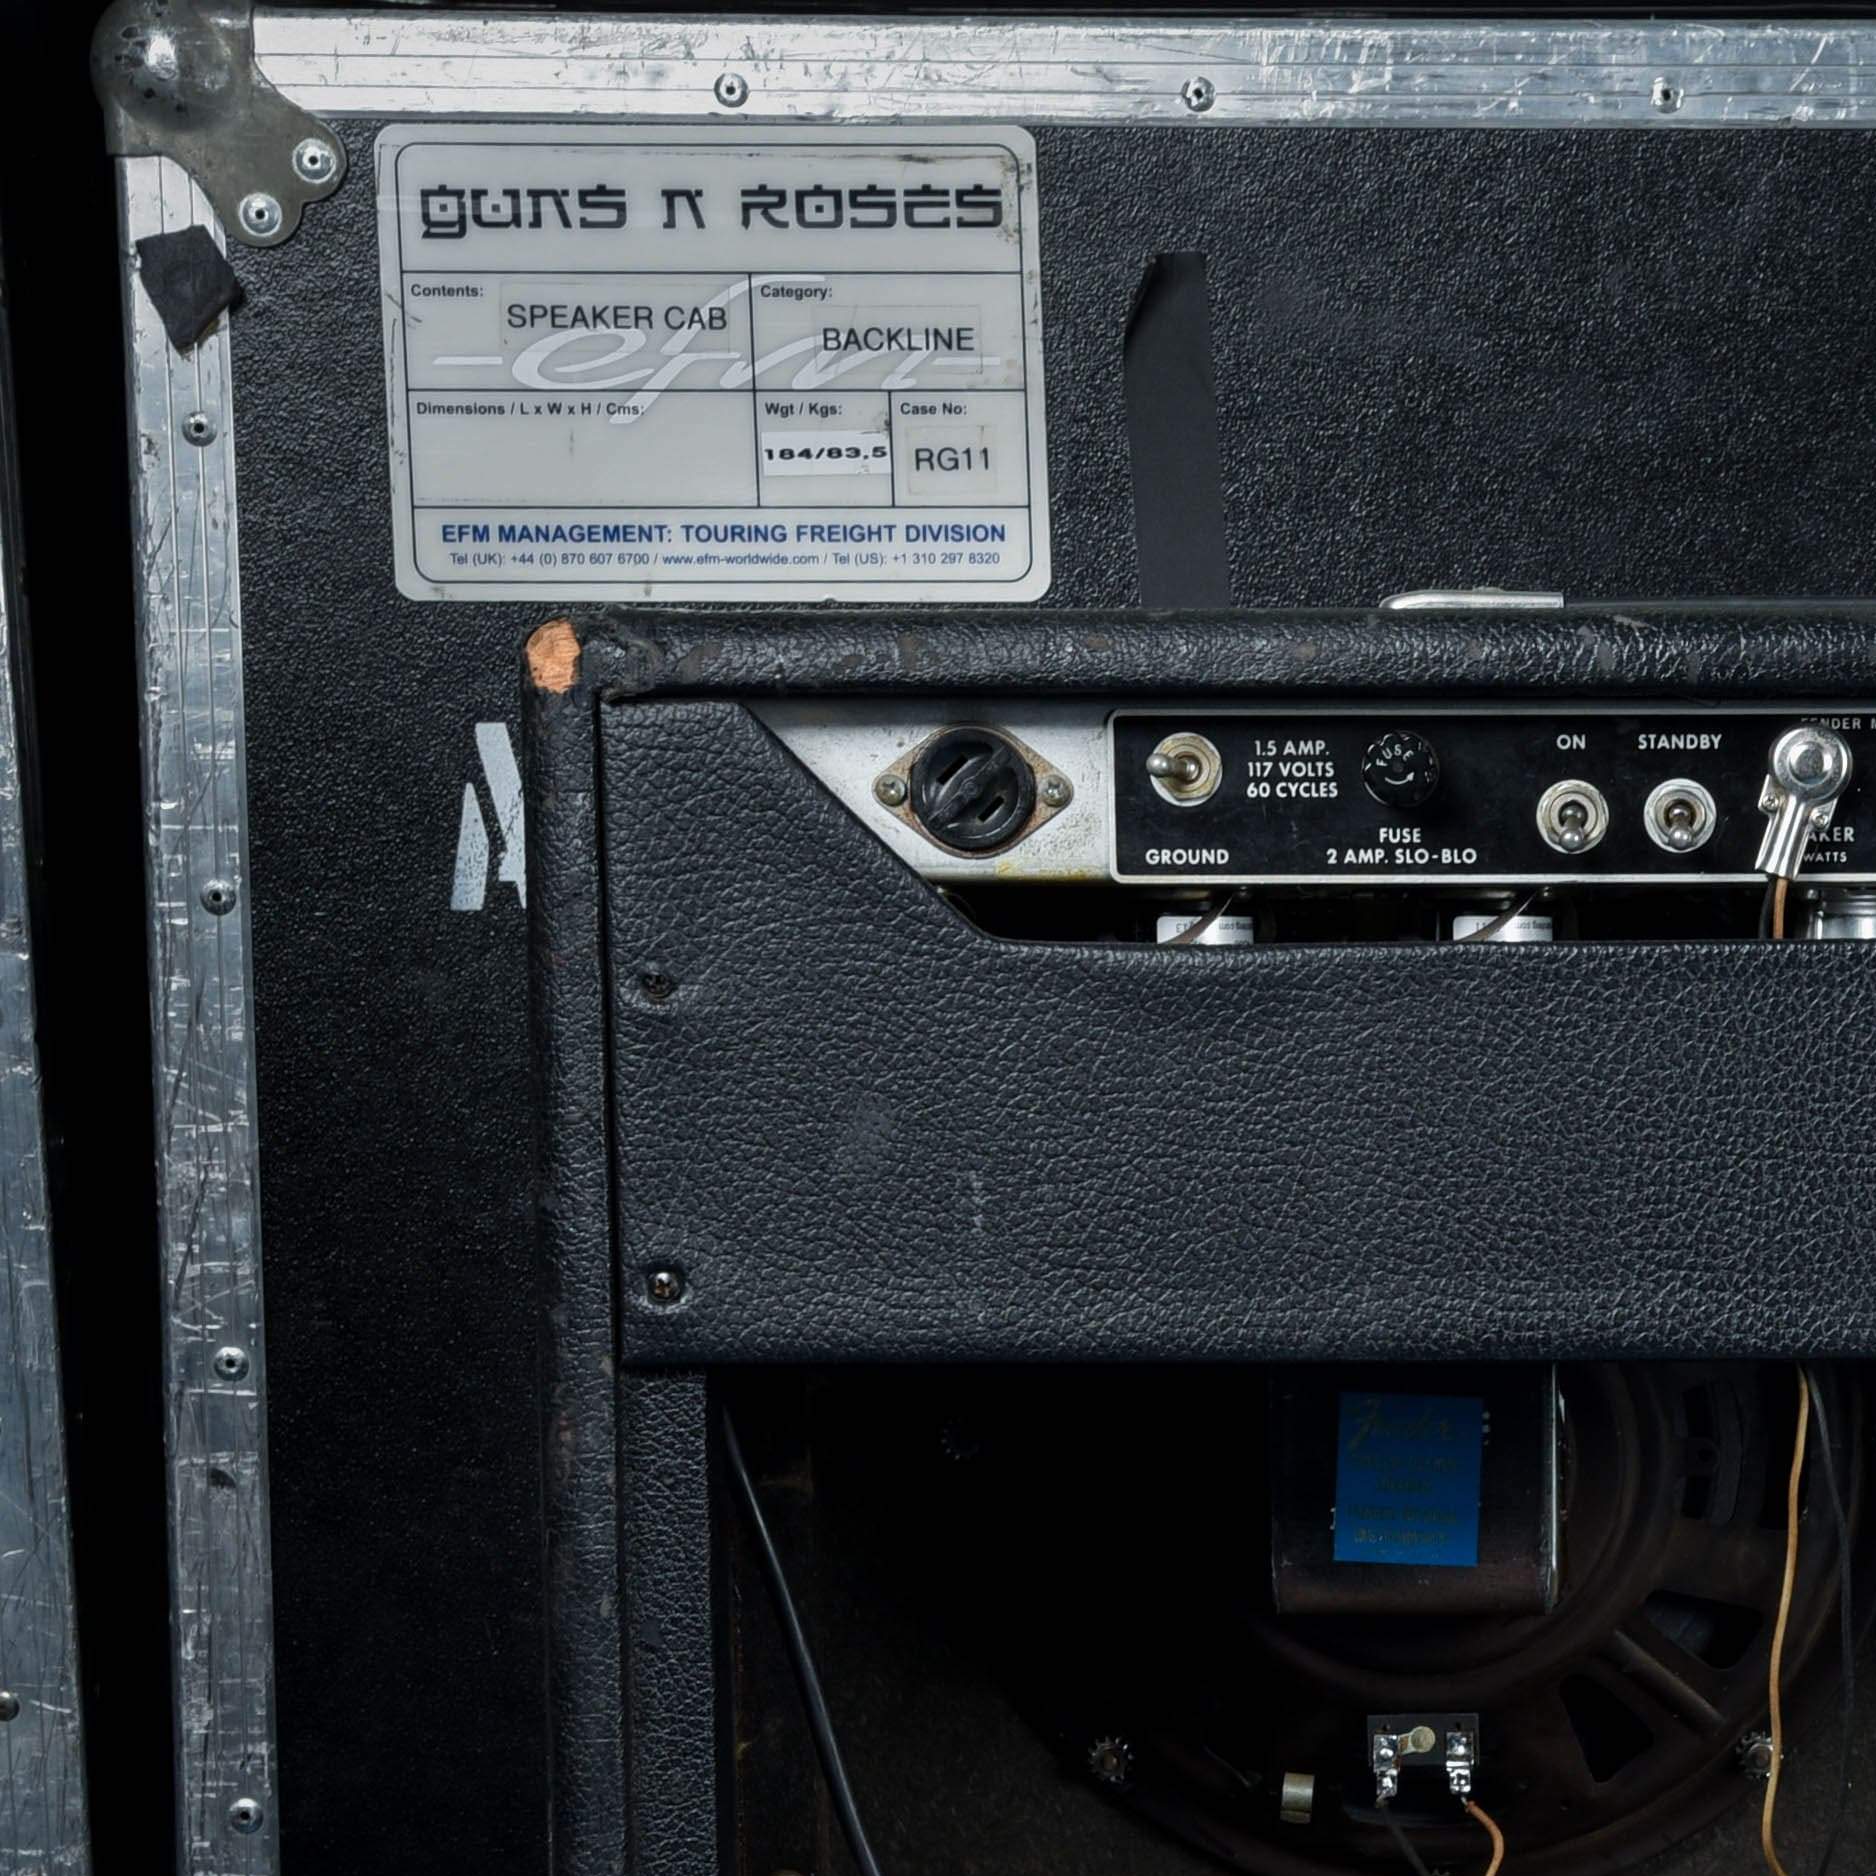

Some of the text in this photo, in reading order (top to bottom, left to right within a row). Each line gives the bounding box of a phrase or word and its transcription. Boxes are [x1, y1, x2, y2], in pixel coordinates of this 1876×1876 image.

[741, 184, 1002, 229] ROSES
[411, 284, 484, 297] Contents:
[760, 285, 832, 300] Category:
[507, 305, 727, 330] SPEAKER CAB
[823, 327, 974, 350] BACKLINE
[416, 402, 505, 416] Dimensions
[521, 403, 528, 415] L
[534, 406, 542, 415] x
[547, 402, 562, 415] W
[567, 406, 575, 416] x
[581, 403, 591, 415] H
[606, 402, 645, 416] Cms:
[765, 403, 795, 417] Wgt
[809, 403, 843, 417] Kgs:
[900, 403, 967, 415] Case No:
[915, 448, 990, 471] RG11
[442, 524, 1006, 543] EFM MANAGEMENT: TOURING FREIGHT DIVISION
[450, 553, 468, 565] Tel
[473, 552, 505, 567] (UK):
[511, 554, 534, 565] +44
[539, 553, 557, 567] (0)
[561, 553, 584, 565] 870
[590, 553, 612, 565] 607
[618, 553, 649, 565] 6700
[662, 553, 819, 565] www.efm-worldwide.com
[833, 553, 850, 564] Tel
[854, 553, 888, 566] (US):
[893, 553, 907, 564] +1
[913, 553, 936, 564] 310
[941, 553, 963, 564] 297
[969, 552, 1000, 564] 8320
[1255, 741, 1330, 756] 1.5 AMP.
[1557, 734, 1585, 750] ON
[1638, 734, 1722, 750] STANDBY
[1376, 744, 1414, 767] FUSE
[1248, 762, 1334, 777] 117 VOLTS
[1247, 782, 1338, 798] 60 CYCLES
[1379, 828, 1421, 843] FUSE
[1145, 849, 1229, 865] GROUND
[1327, 848, 1477, 864] 2 AMP. SLO-BLO
